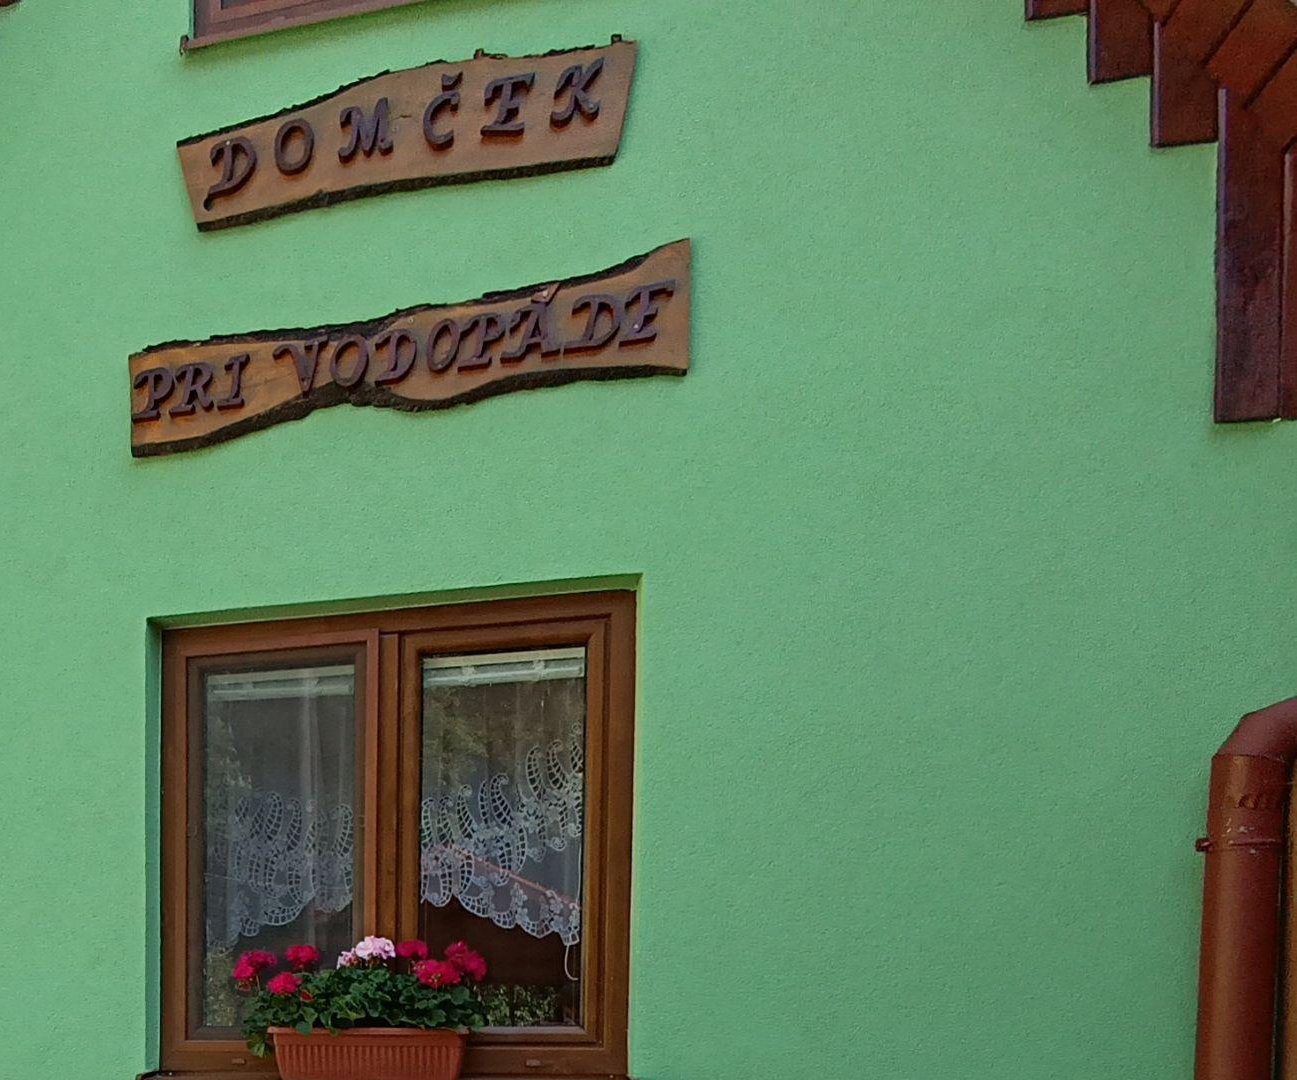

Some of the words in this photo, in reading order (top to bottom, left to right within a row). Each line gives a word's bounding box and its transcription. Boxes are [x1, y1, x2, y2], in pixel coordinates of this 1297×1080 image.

[204, 60, 605, 210] DOMČEK
[132, 353, 249, 421] PRI
[273, 280, 676, 393] VODOPÁDE
